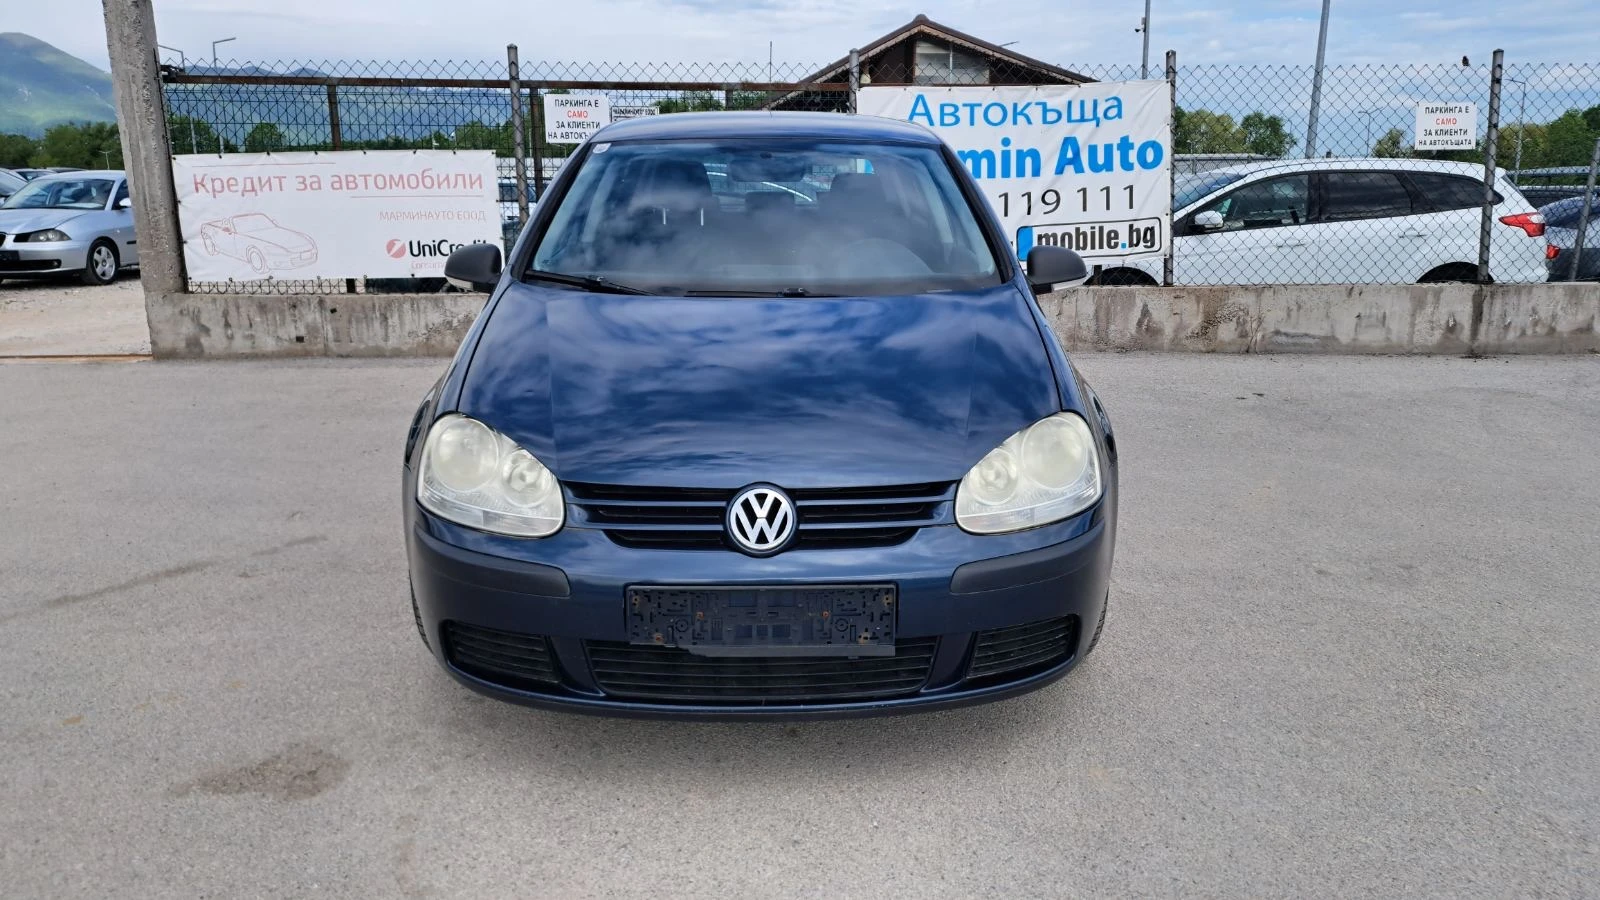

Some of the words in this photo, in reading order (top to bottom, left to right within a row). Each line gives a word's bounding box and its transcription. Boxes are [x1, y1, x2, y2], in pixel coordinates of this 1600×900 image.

[554, 99, 592, 107] ПАРКИНГА
[594, 99, 599, 107] Е
[567, 110, 588, 118] САМО
[908, 93, 1123, 127] Автокъща
[1424, 106, 1463, 114] ПАРКИНГА
[555, 120, 566, 129] ЗА
[567, 121, 600, 129] КЛИЕНТИ
[547, 131, 558, 140] НА
[1423, 129, 1433, 137] ЗА
[1054, 134, 1164, 175] Auto
[193, 173, 287, 199] Кредит
[295, 174, 323, 192] за
[330, 167, 483, 191] автомобили
[998, 188, 1061, 218] 119
[1076, 184, 1135, 213] 111
[1037, 223, 1156, 251] mobile.bg
